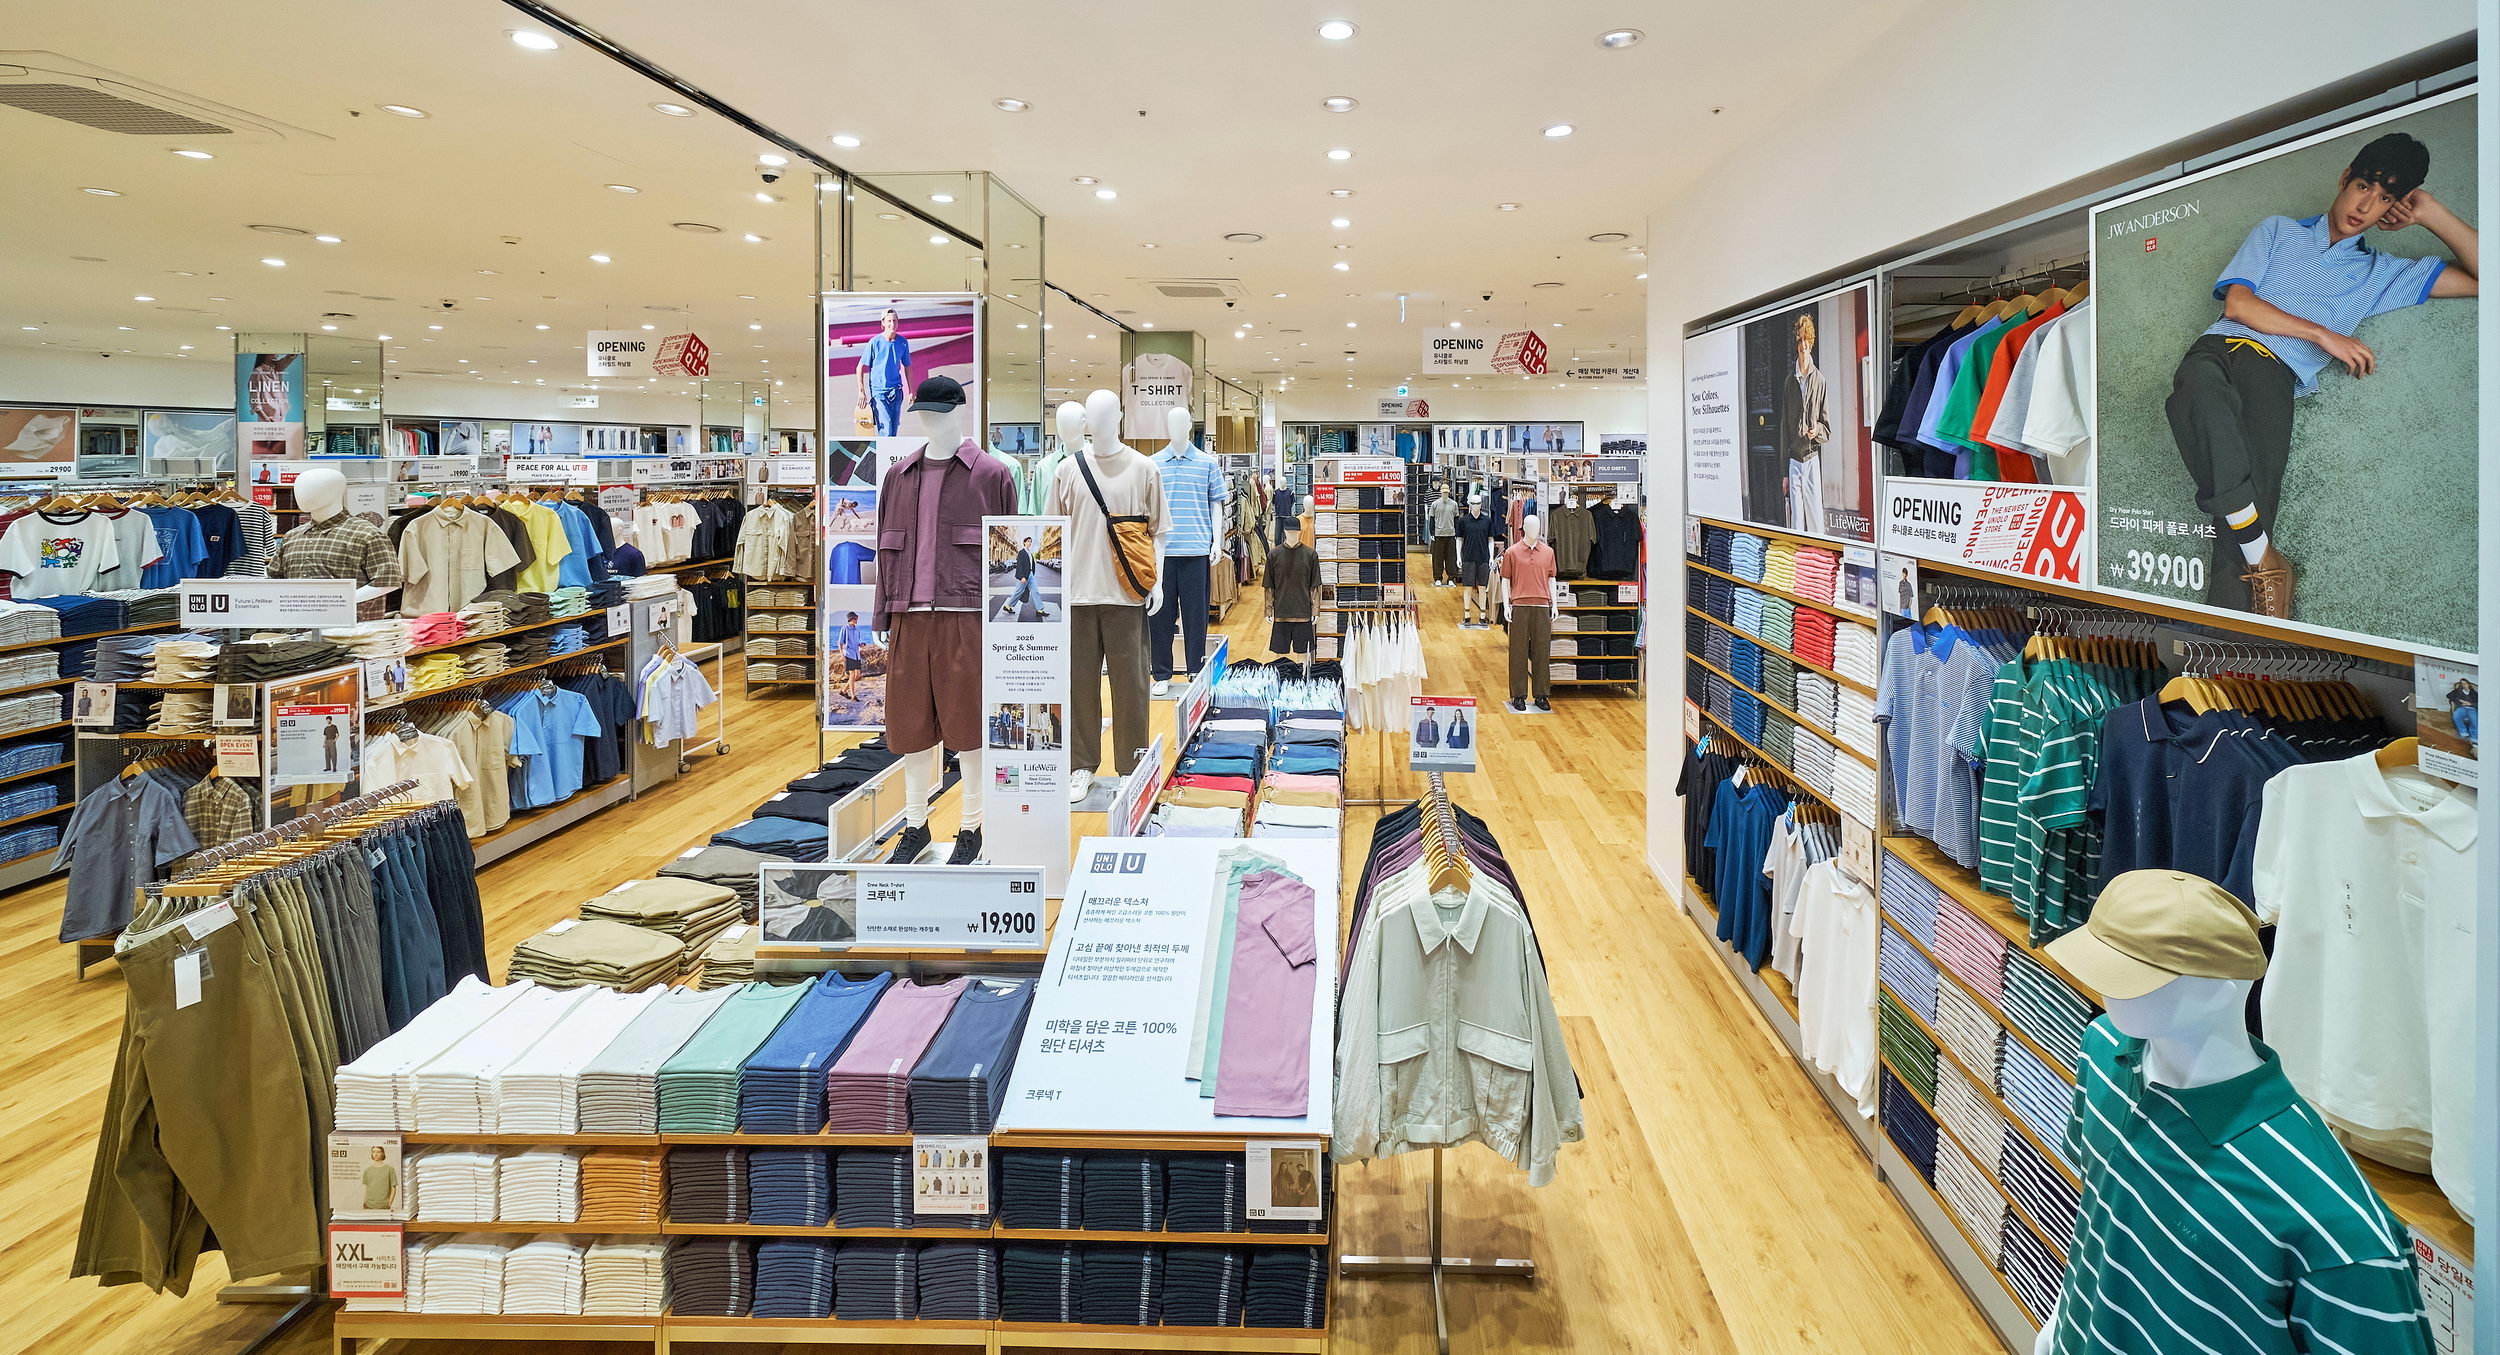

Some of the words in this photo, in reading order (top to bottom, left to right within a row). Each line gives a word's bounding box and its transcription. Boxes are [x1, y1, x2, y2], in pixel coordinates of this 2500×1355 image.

[597, 341, 646, 352] OPENING
[1433, 339, 1484, 350] OPENING
[1622, 367, 1640, 375] 계산대
[249, 381, 290, 393] LINEN
[1131, 384, 1183, 396] T-SHIRT
[1893, 496, 1962, 526] OPENING
[1992, 507, 2002, 515] THE
[2004, 503, 2029, 513] NEWEST
[2110, 506, 2118, 515] Dry
[1828, 513, 1871, 533] LifeWear
[1987, 515, 2009, 524] UNIQLO
[1984, 525, 2002, 533] STORE
[2109, 517, 2140, 532] 드라이
[2141, 519, 2164, 534] 피케
[2165, 521, 2189, 537] 폴로
[2191, 526, 2217, 539] 셔츠
[1891, 524, 1913, 538] 유니클로
[1914, 526, 1937, 541] 스타필드
[1938, 531, 1957, 544] 하남점
[190, 595, 206, 603] UNI
[215, 596, 226, 611] U
[190, 603, 206, 612] QLO
[992, 643, 1018, 653] Spring
[1018, 643, 1025, 651] &
[1026, 643, 1059, 652] Summer
[1005, 653, 1045, 661] Collection
[1023, 763, 1058, 771] LifeWear
[1097, 854, 1114, 863] UNI
[1126, 855, 1141, 871] U
[1093, 863, 1113, 872] QLO
[1026, 882, 1033, 892] U
[866, 890, 897, 902] 크루넥
[899, 890, 906, 901] T
[1088, 897, 1122, 907] 매끄러운
[1123, 897, 1149, 907] 텍스처
[1075, 943, 1094, 953] 고심
[1095, 943, 1114, 953] 끝에
[1115, 943, 1142, 954] 찾아낸
[1143, 944, 1170, 954] 최적의
[1171, 944, 1190, 954] 두께
[1045, 1019, 1082, 1035] 미학을
[1085, 1019, 1110, 1034] 담은
[1111, 1020, 1138, 1035] 코튼
[1141, 1021, 1178, 1034] 100%
[1039, 1038, 1066, 1054] 원단
[1068, 1038, 1106, 1054] 티셔츠
[1025, 1089, 1054, 1101] 크루넥
[1055, 1089, 1063, 1100] T
[2416, 1239, 2432, 1254] UNI
[335, 1243, 374, 1262] XXL
[2416, 1246, 2432, 1260] QLO
